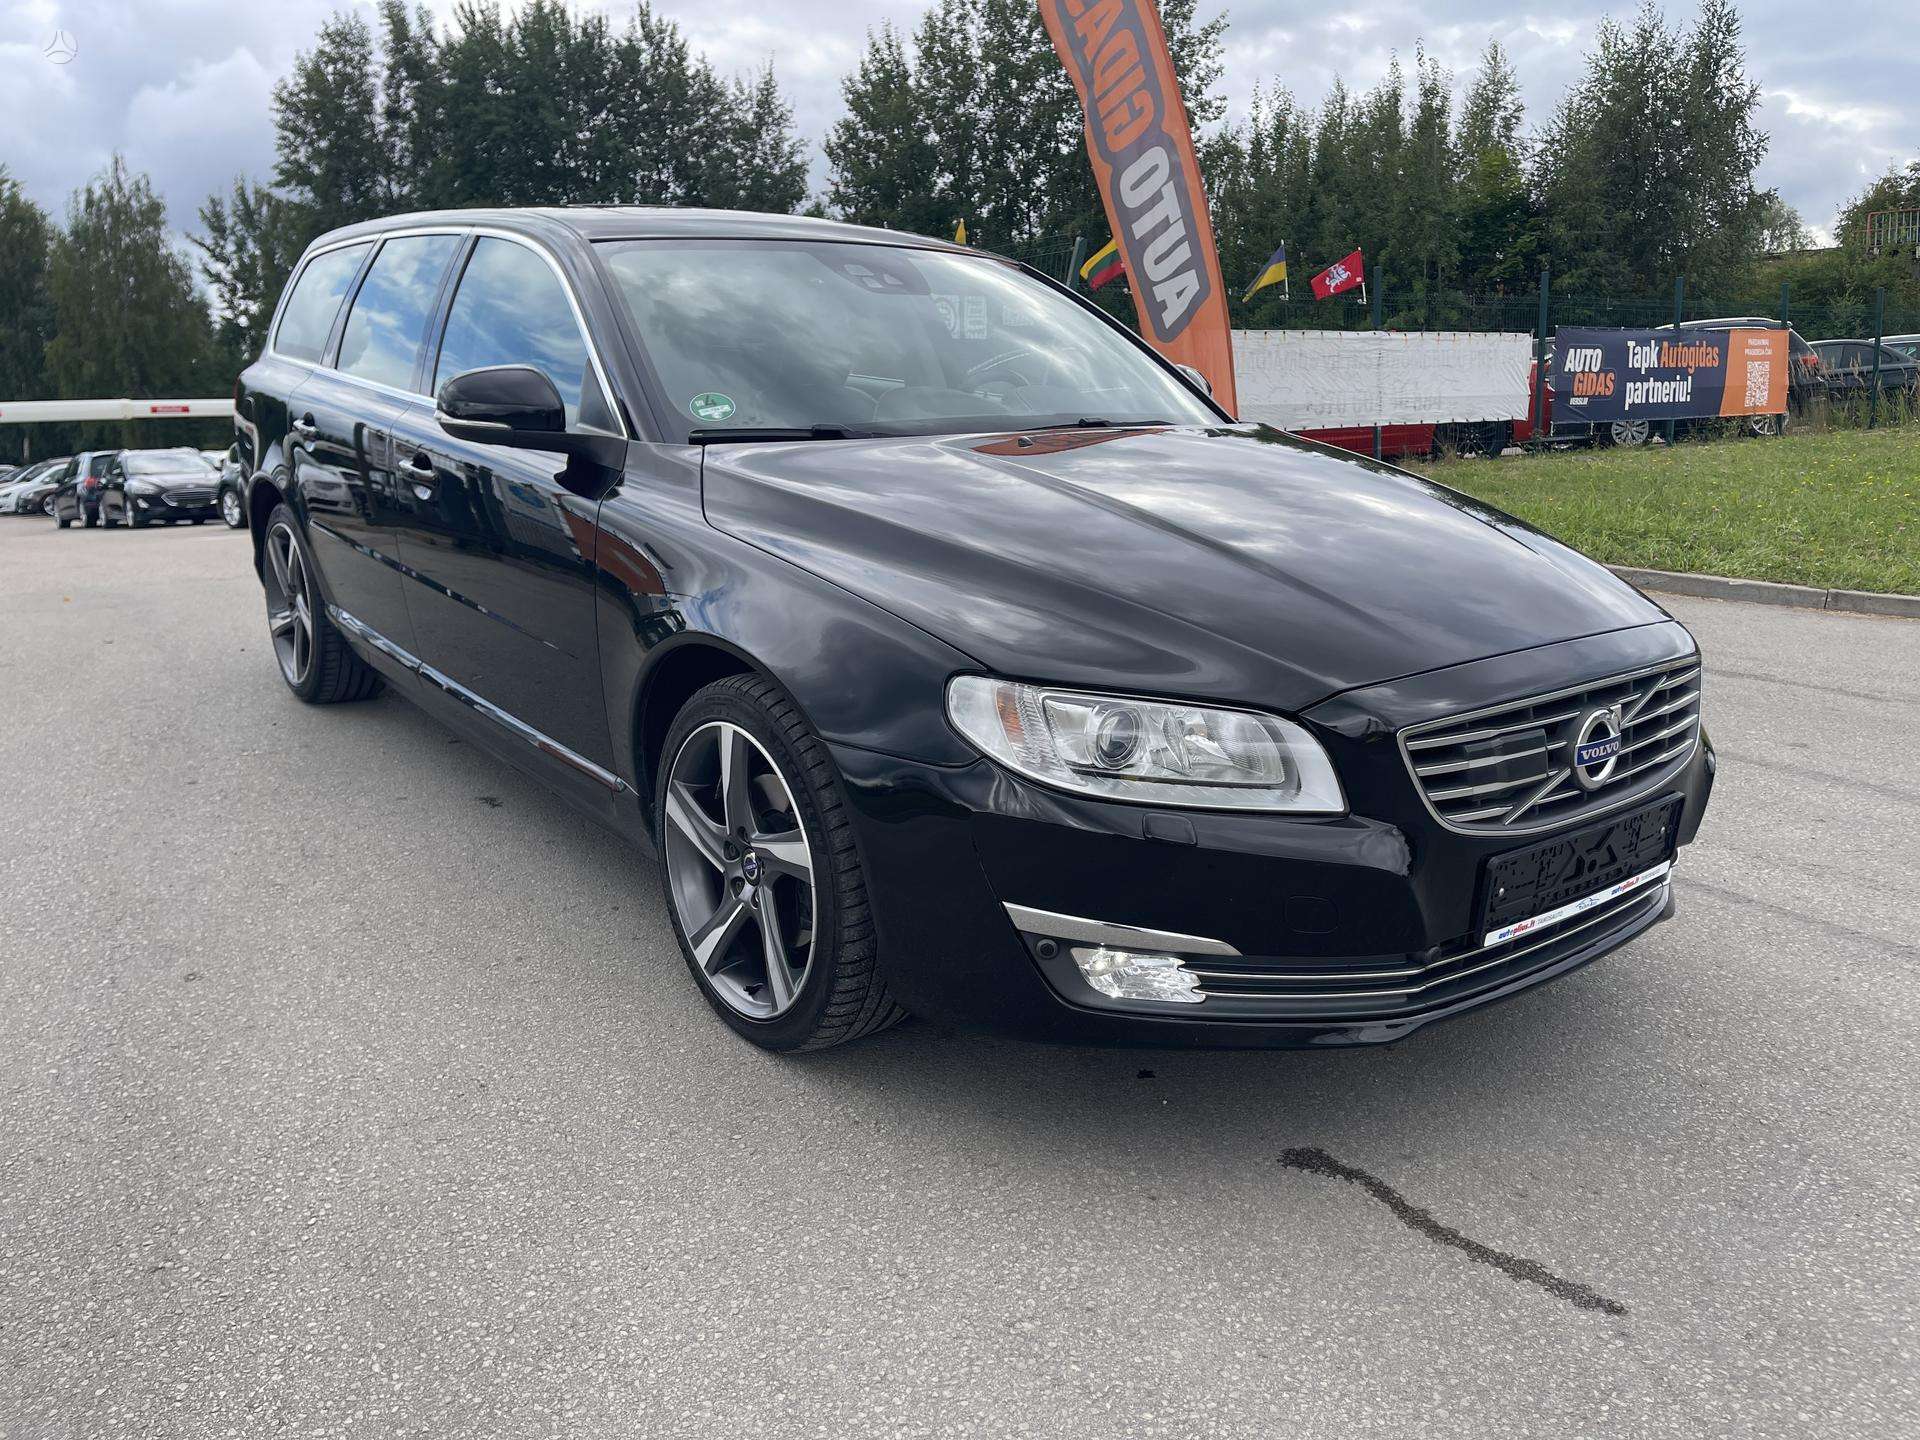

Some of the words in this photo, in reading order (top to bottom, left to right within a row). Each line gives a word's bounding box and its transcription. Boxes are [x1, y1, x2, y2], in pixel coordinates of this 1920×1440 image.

[1564, 348, 1603, 373] AUTO
[1626, 340, 1659, 374] Tapk
[1660, 341, 1720, 374] Autogidas
[1573, 372, 1616, 397] GIDAS
[1624, 375, 1693, 411] partneriu!
[1580, 741, 1620, 760] VOLVO
